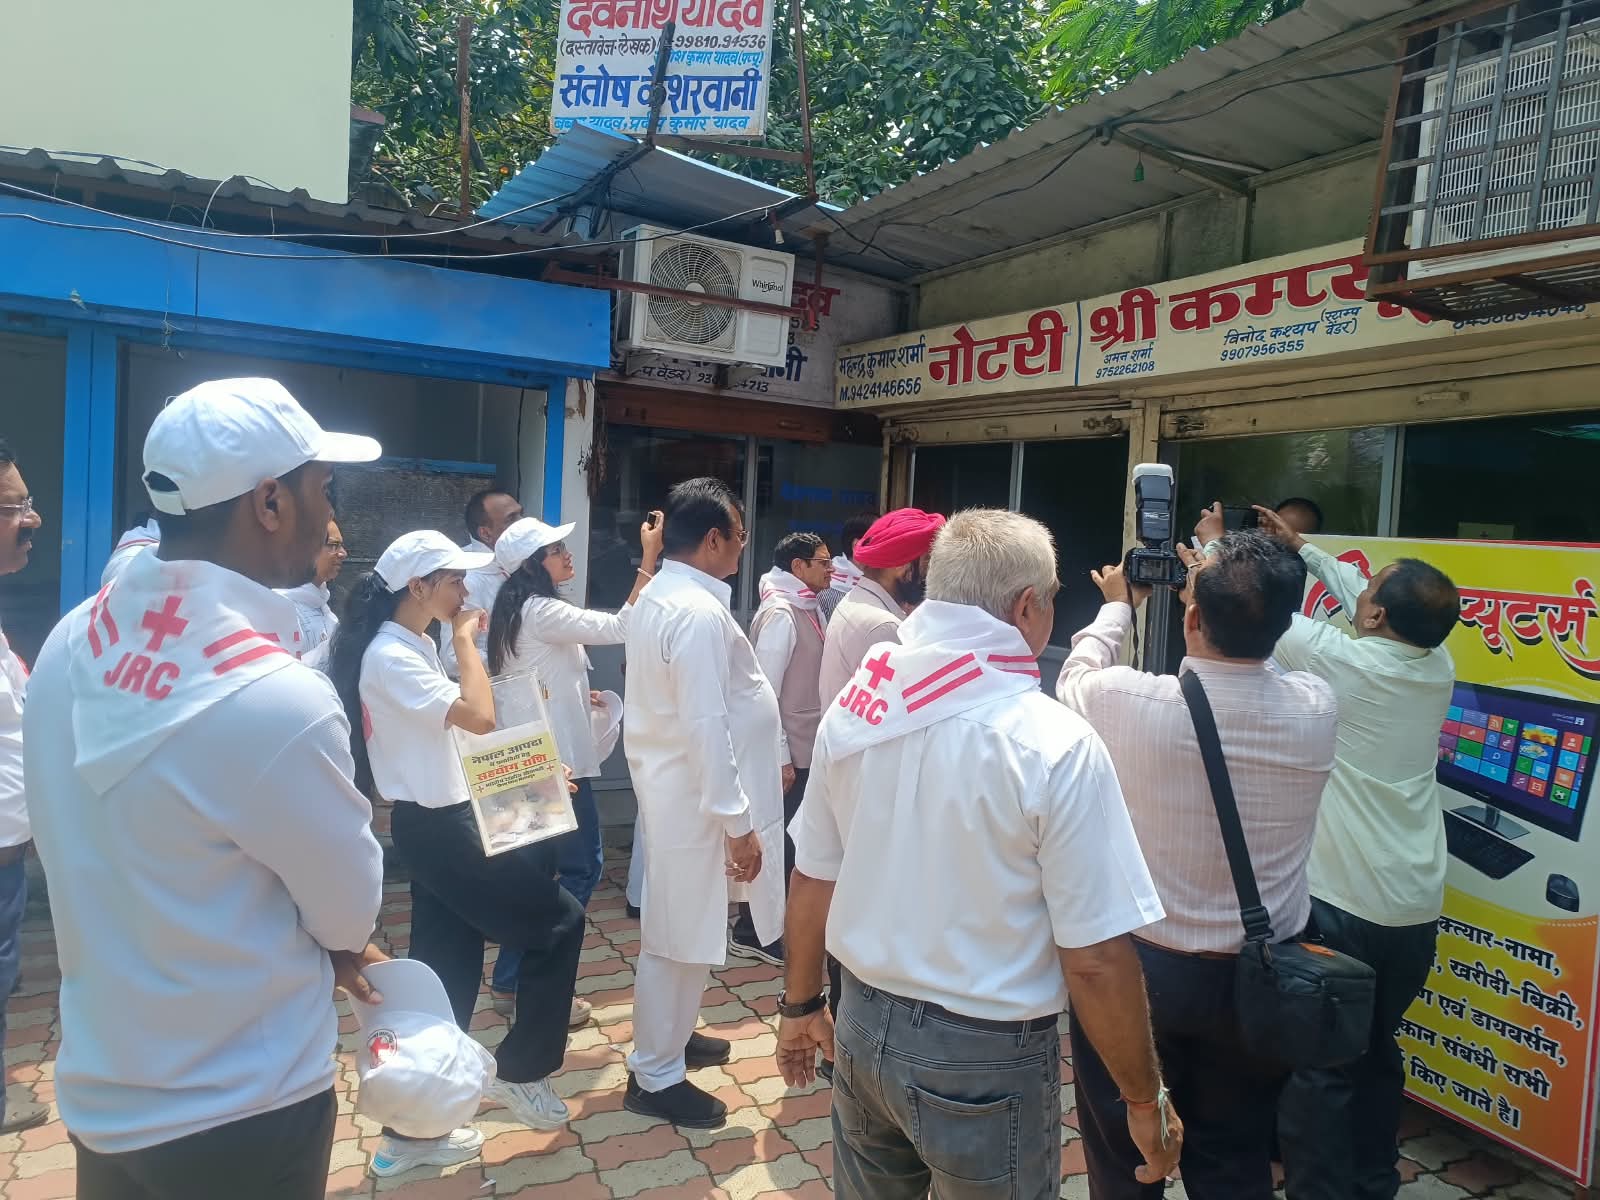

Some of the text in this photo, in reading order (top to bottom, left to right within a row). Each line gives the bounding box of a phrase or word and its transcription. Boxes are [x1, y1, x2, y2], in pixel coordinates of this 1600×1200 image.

[560, 64, 639, 109] संतोष
[669, 116, 708, 134] कुमार
[712, 116, 750, 130] यादव
[752, 279, 784, 293] Whirlpool
[1089, 288, 1161, 352] श्री
[1224, 325, 1267, 346] विनोद
[866, 348, 897, 379] कुमार
[898, 334, 926, 368] शर्मा
[928, 309, 1070, 387] नोटरी
[1095, 360, 1155, 379] 9752262108
[1103, 341, 1154, 365] अमन शर्मा
[1220, 339, 1305, 362] 9907956355
[103, 651, 181, 701] JRC
[838, 684, 889, 726] JRC
[1438, 993, 1468, 1020] एवं
[1470, 1007, 1566, 1066] डायवर्सन,
[1409, 1055, 1448, 1094] किए
[1451, 1079, 1494, 1113] जाते
[1440, 1036, 1499, 1075] संबंधी
[1502, 1062, 1551, 1099] सभी
